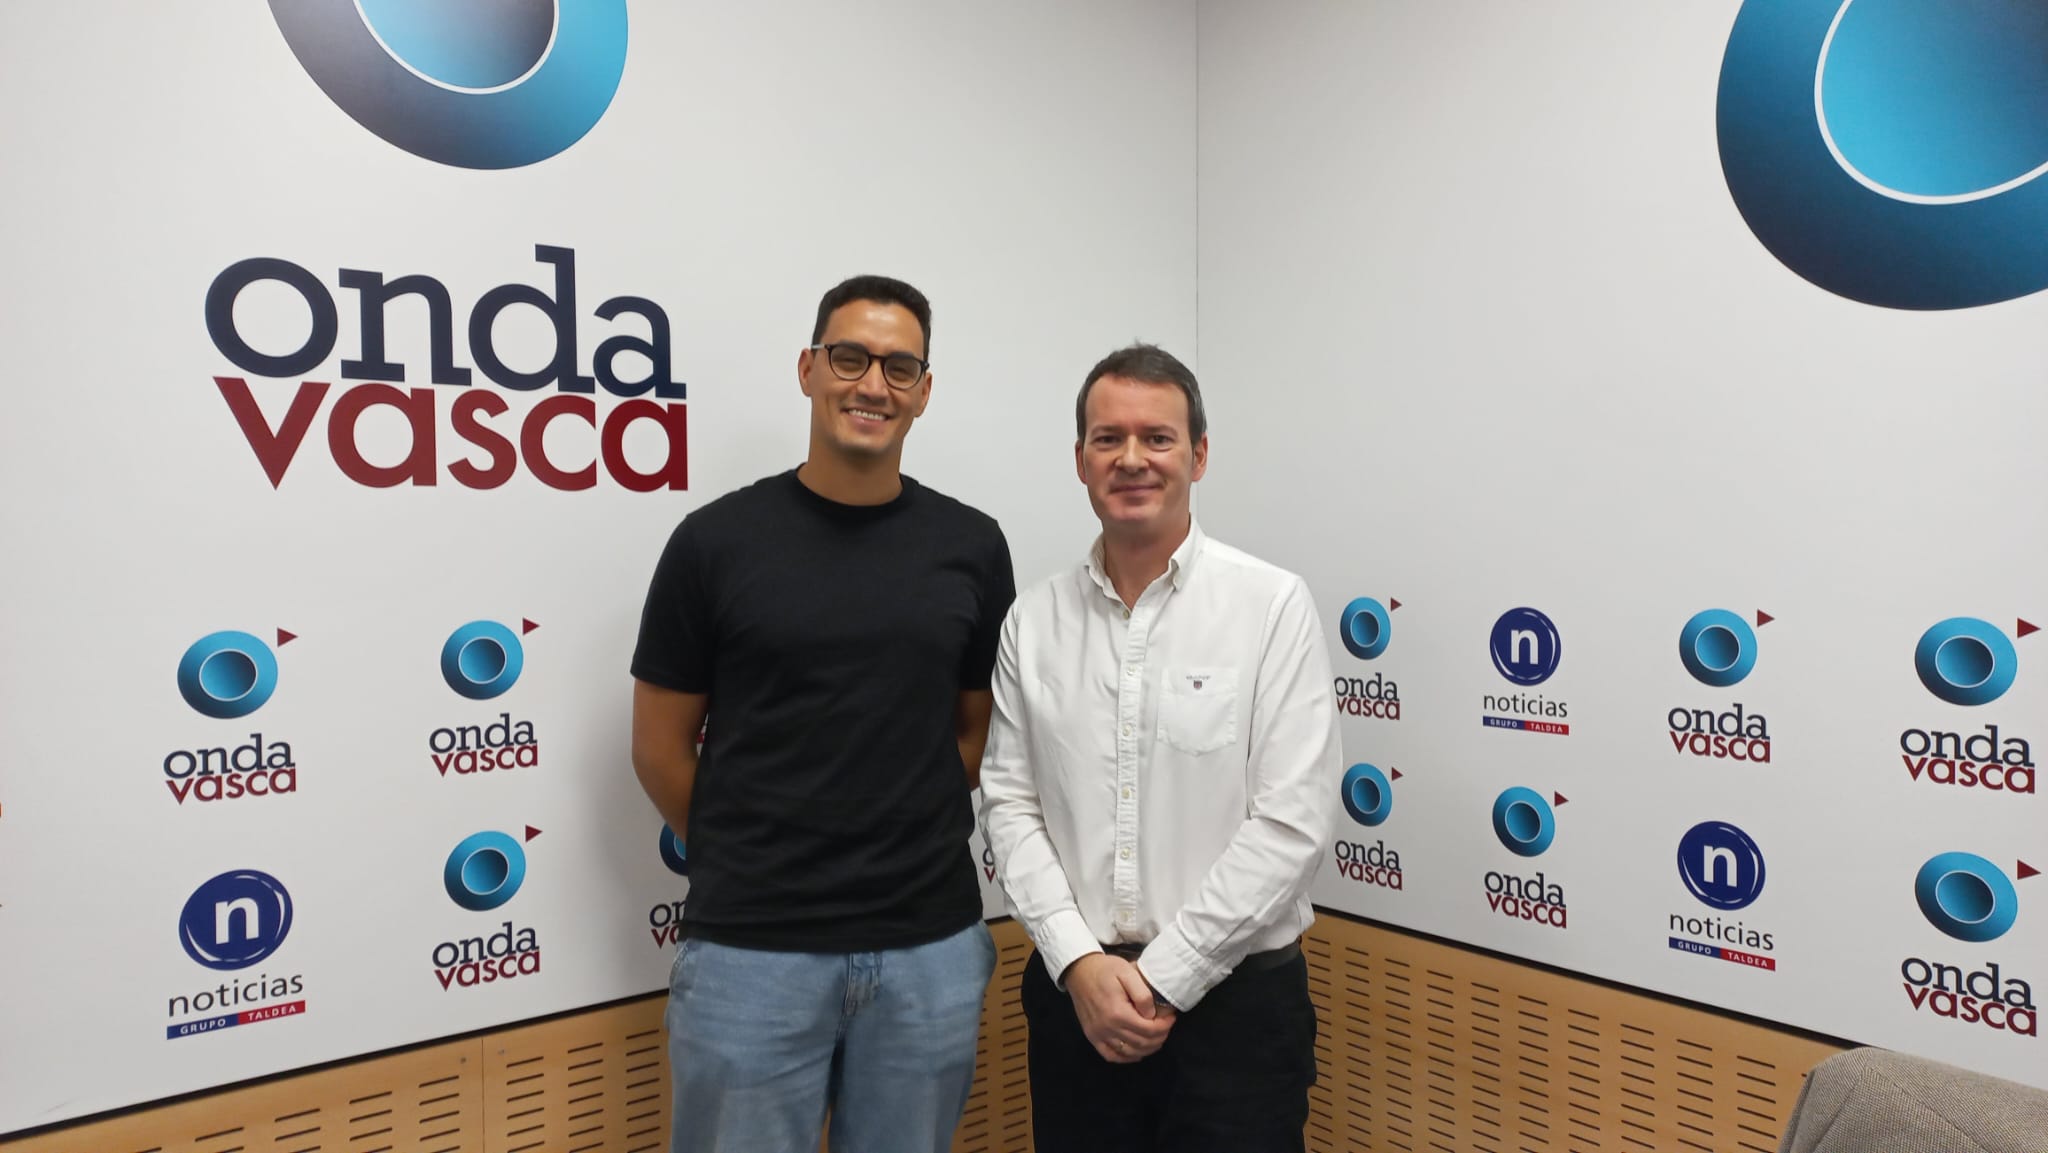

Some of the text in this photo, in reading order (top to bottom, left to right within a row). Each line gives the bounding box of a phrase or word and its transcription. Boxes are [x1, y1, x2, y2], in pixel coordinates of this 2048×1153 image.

[204, 242, 687, 400] onda
[213, 375, 689, 493] vasca
[1510, 628, 1540, 665] n
[1334, 672, 1400, 701] onda
[1336, 696, 1400, 721] vasca
[1483, 693, 1568, 719] noticias
[1668, 703, 1771, 740] onda
[429, 713, 538, 754] onda
[1530, 722, 1564, 734] TALDEA
[1669, 730, 1771, 763] vasca
[1900, 725, 2035, 768] onda
[163, 733, 296, 779] onda
[431, 742, 539, 777] vasca
[1902, 754, 2036, 794] vasca
[165, 767, 297, 805] vasca
[1335, 840, 1401, 872] onda
[1336, 859, 1402, 891] vasca
[1704, 843, 1738, 888] n
[1485, 871, 1567, 908] onda
[215, 894, 260, 945] n
[1486, 892, 1567, 929] vasca
[431, 922, 540, 969] onda
[1669, 913, 1774, 952] noticias
[433, 949, 541, 991] vasca
[1678, 940, 1768, 968] GRUPO TALDEA
[169, 973, 304, 1018] noticias
[1901, 957, 2036, 1010] onda
[180, 1004, 297, 1036] GRUPO TALDEA
[1903, 983, 2037, 1037] vasca
